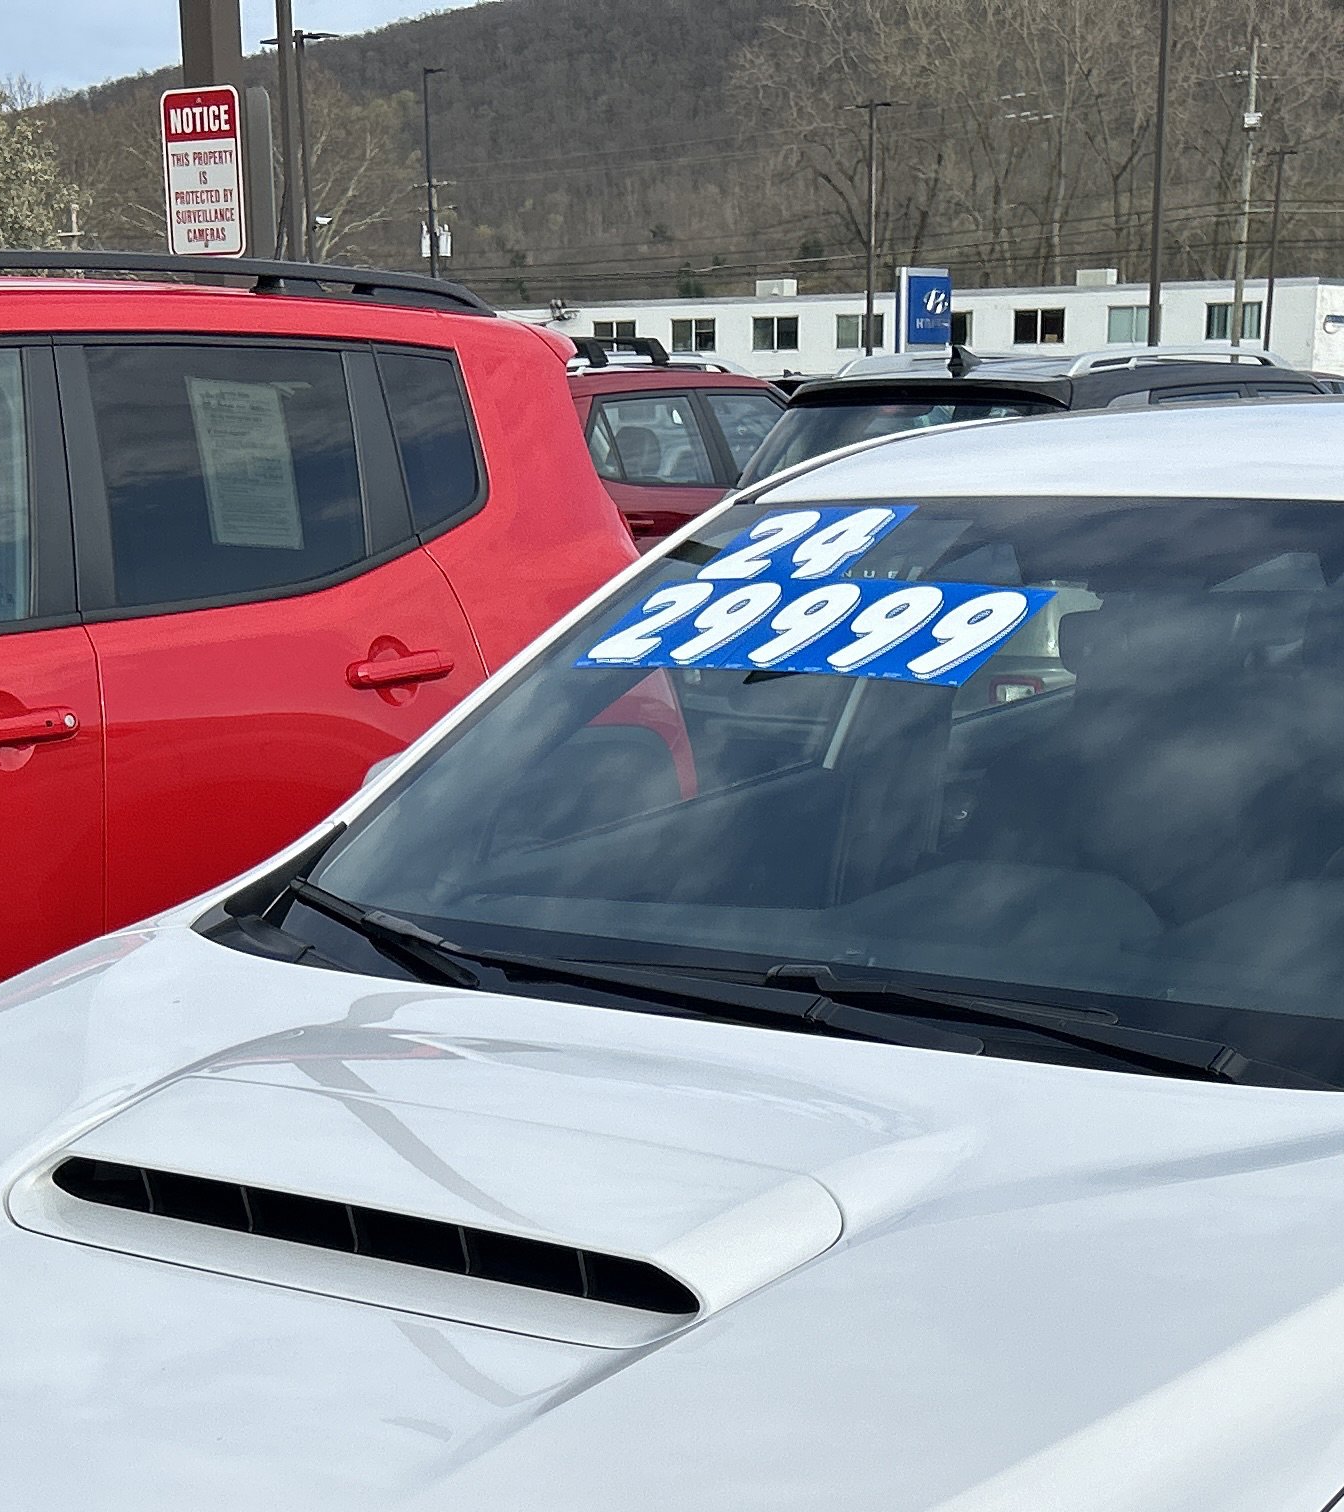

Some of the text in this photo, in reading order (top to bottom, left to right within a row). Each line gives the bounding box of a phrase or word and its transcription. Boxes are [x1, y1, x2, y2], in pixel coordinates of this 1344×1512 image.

[169, 105, 230, 134] NOTICE
[171, 150, 233, 167] THIS PROPERTY
[199, 171, 208, 185] IS
[175, 188, 233, 205] PROTECTED BY
[176, 208, 235, 224] SURVEILLANCE
[187, 227, 226, 242] CAMERAS
[696, 508, 898, 580] 24
[587, 581, 1030, 681] 29999
